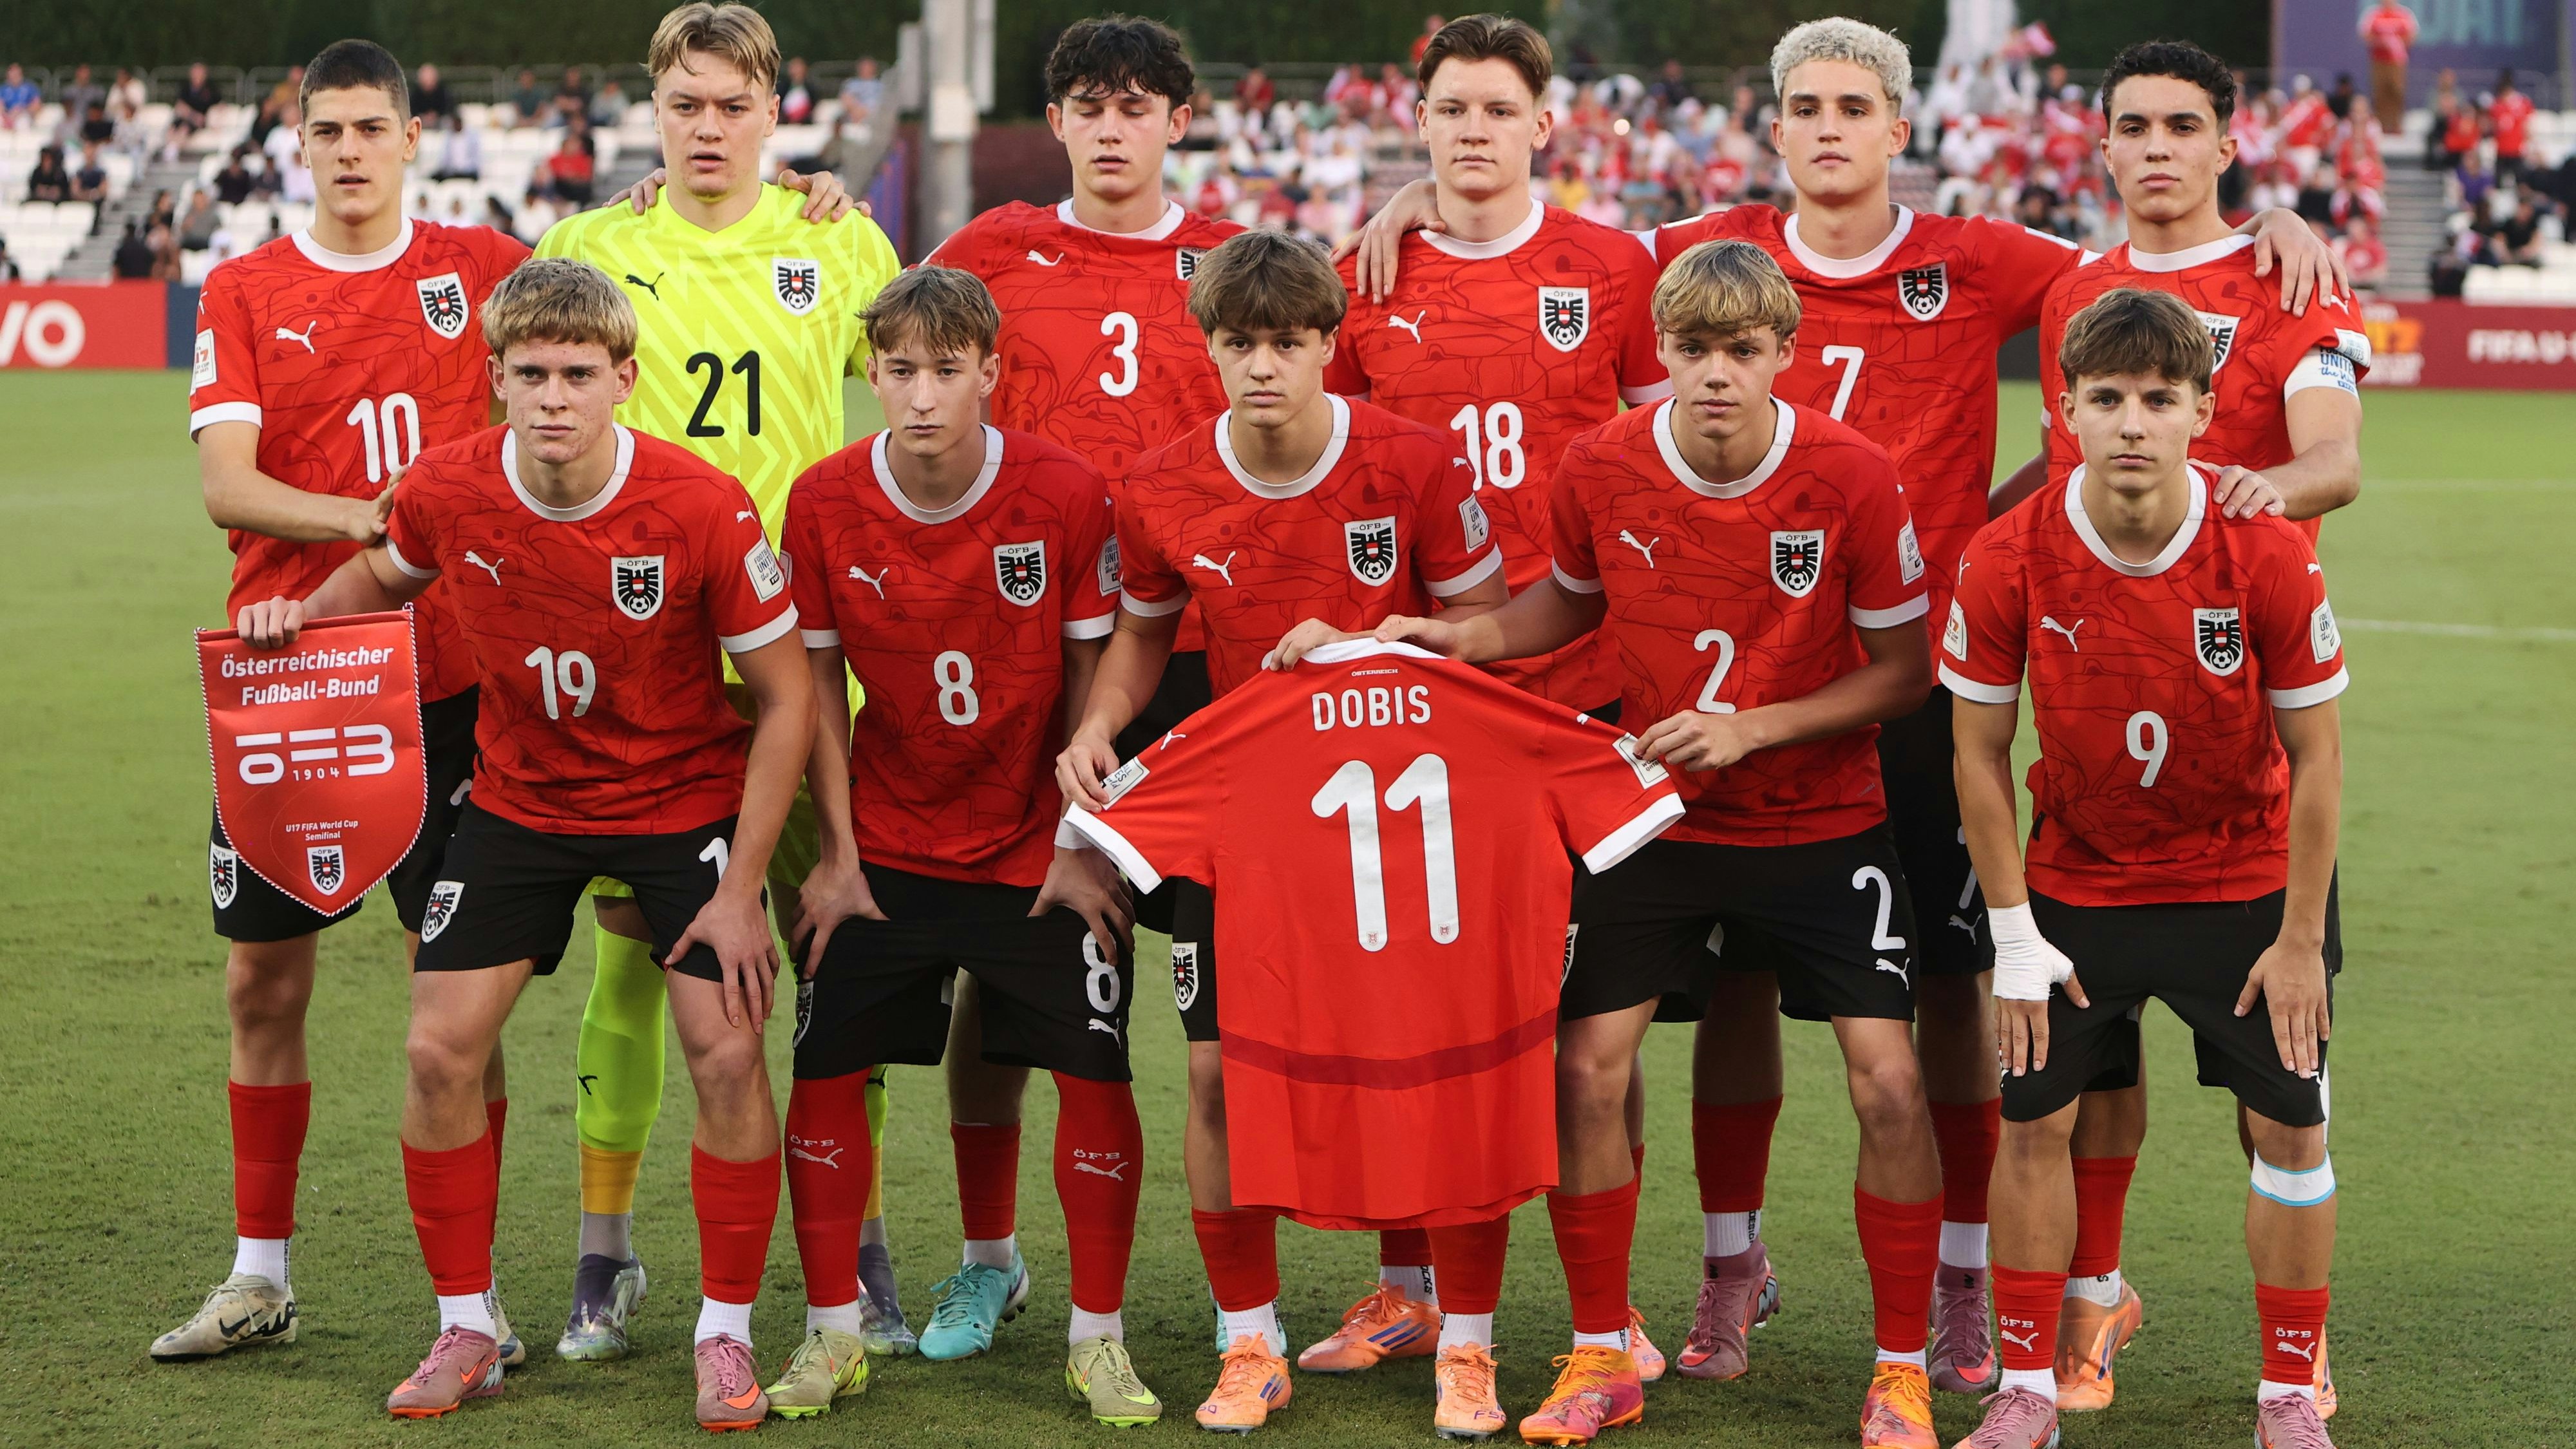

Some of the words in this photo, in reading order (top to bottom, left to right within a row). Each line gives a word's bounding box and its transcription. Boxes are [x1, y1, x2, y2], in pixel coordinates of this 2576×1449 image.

[1099, 312, 1139, 397] 3
[1822, 345, 1865, 422] 7
[686, 350, 761, 437] 21
[346, 393, 421, 483] 10
[1450, 402, 1526, 491] 18
[222, 646, 394, 677] Österreichischer
[242, 675, 380, 706] Fußball-Bund
[525, 646, 596, 720] 19
[934, 650, 979, 725] 8
[1694, 629, 1736, 715] 2
[1312, 685, 1432, 731] DOBIS
[293, 766, 339, 781] 1904
[2126, 710, 2168, 788] 9
[285, 824, 300, 833] U17
[301, 822, 318, 831] FIFA
[319, 820, 342, 829] World
[344, 820, 359, 829] Cup
[305, 831, 341, 841] Semifinal
[1311, 753, 1459, 952] 11
[1852, 866, 1906, 951] 2
[1082, 930, 1121, 1013] 8
[790, 1134, 835, 1147] ÖFB
[1074, 1148, 1120, 1160] ÖFB
[2000, 1314, 2034, 1329] ÖFB
[2275, 1327, 2312, 1338] ÖFB
